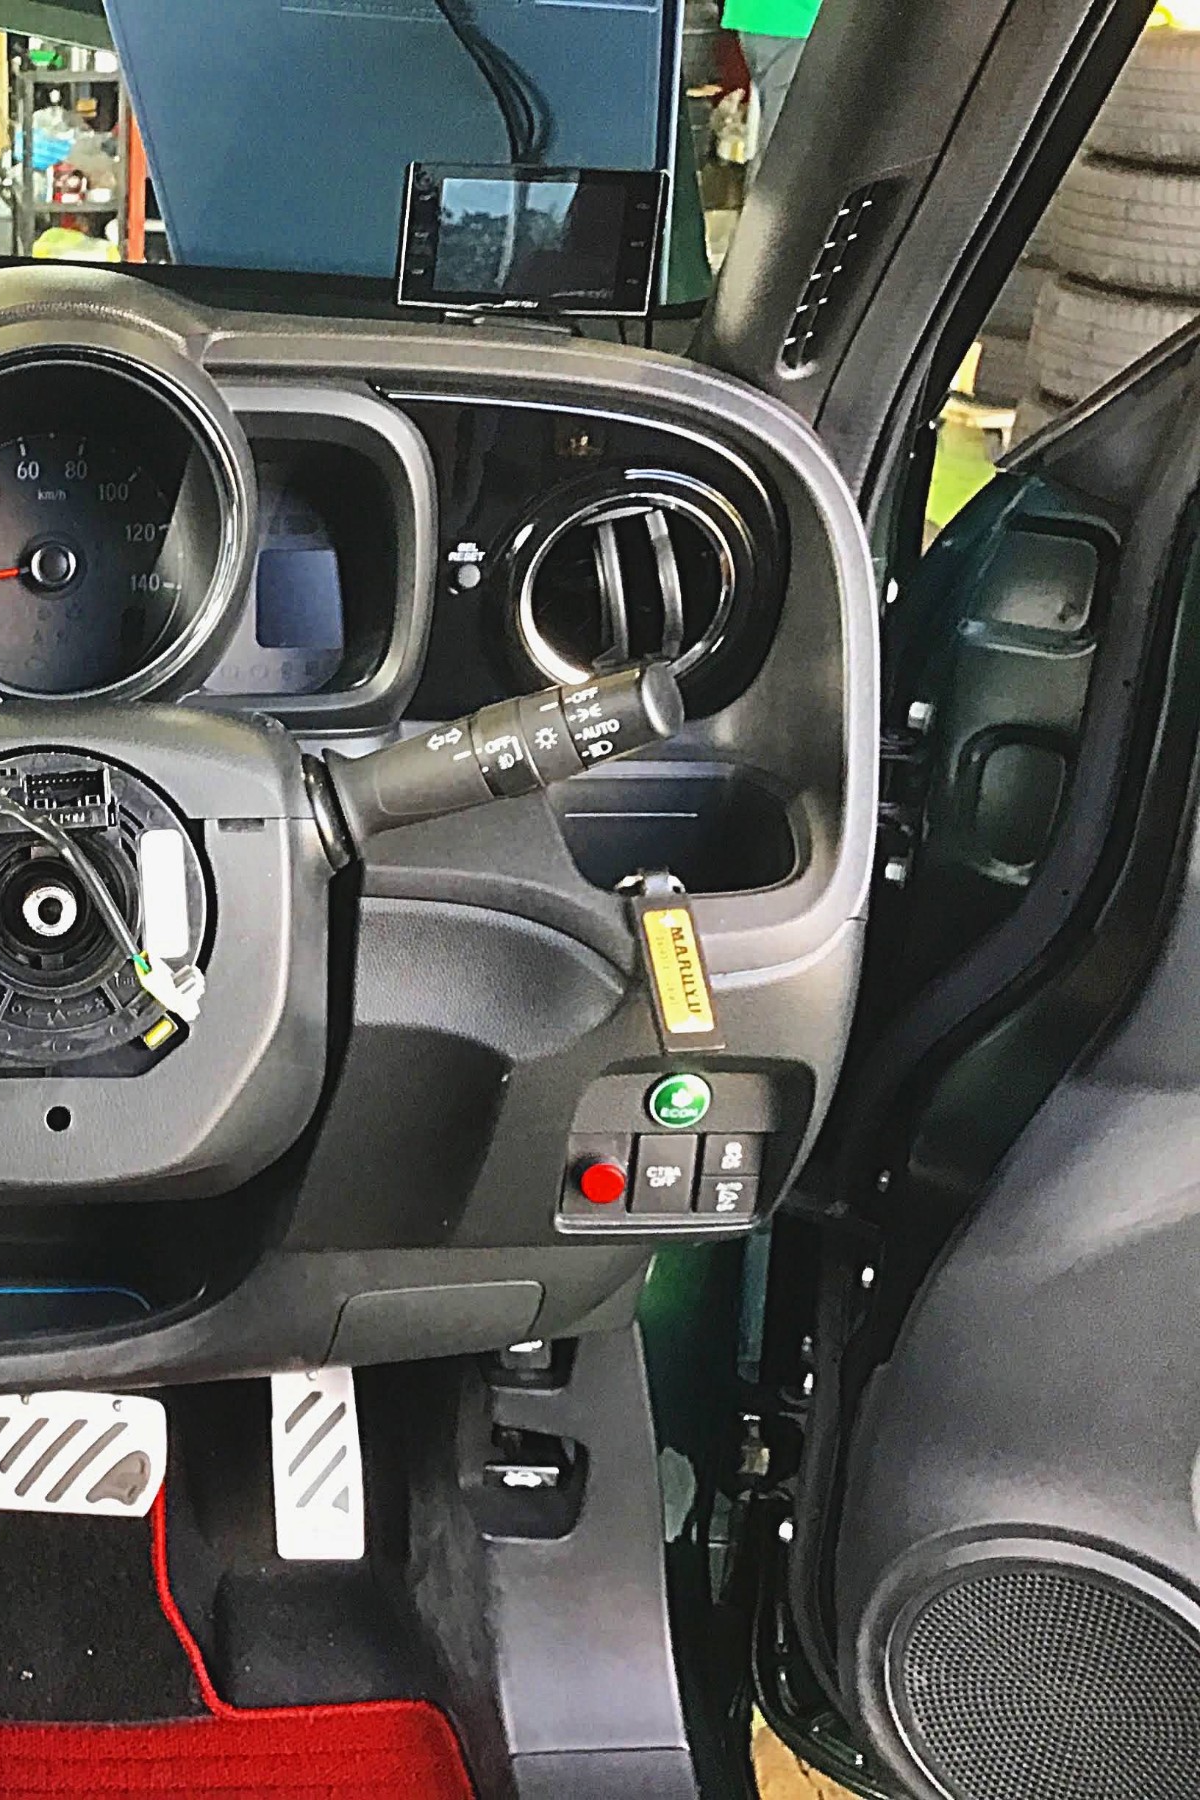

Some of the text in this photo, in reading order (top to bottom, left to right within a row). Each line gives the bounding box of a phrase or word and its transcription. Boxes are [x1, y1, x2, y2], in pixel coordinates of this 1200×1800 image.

[17, 461, 39, 480] 60
[65, 461, 87, 480] 80
[37, 489, 66, 500] km/h
[99, 483, 129, 501] 100
[125, 524, 155, 542] 120
[449, 551, 485, 561] RESET
[130, 574, 160, 592] 140
[572, 687, 599, 704] OFF
[582, 718, 621, 741] AUTO
[485, 735, 511, 754] OFF
[660, 1107, 698, 1118] ECON
[650, 1176, 676, 1188] OFF
